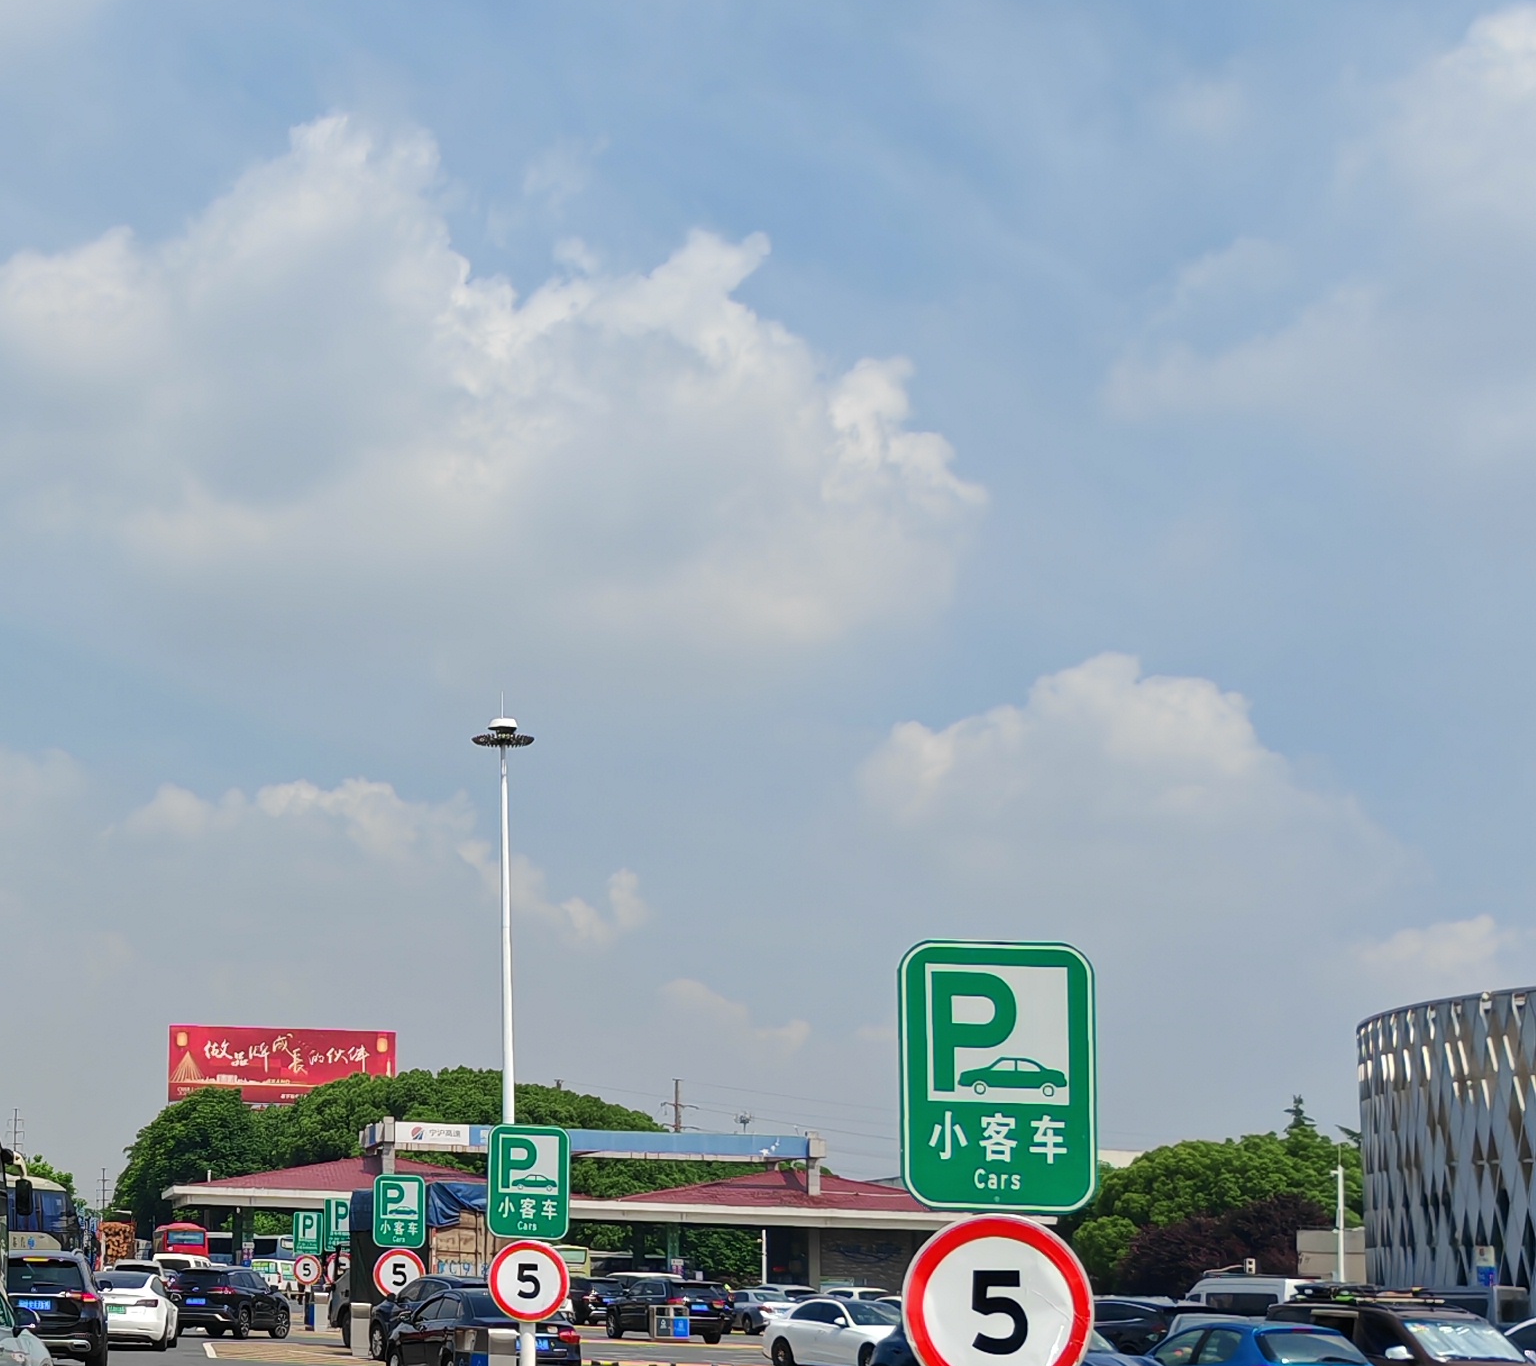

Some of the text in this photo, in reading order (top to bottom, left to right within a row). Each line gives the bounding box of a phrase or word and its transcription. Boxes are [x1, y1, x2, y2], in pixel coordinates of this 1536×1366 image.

[931, 971, 1016, 1092] P
[929, 1111, 1068, 1164] 小客车
[502, 1137, 537, 1189] P
[974, 1169, 1021, 1191] Cars
[382, 1183, 404, 1215] P
[498, 1196, 558, 1221] 小客车
[380, 1220, 418, 1235] 小客车
[517, 1221, 537, 1231] Cars
[302, 1263, 312, 1277] 5
[392, 1263, 407, 1286] 5
[517, 1263, 541, 1299] 5
[971, 1270, 1028, 1355] 5
